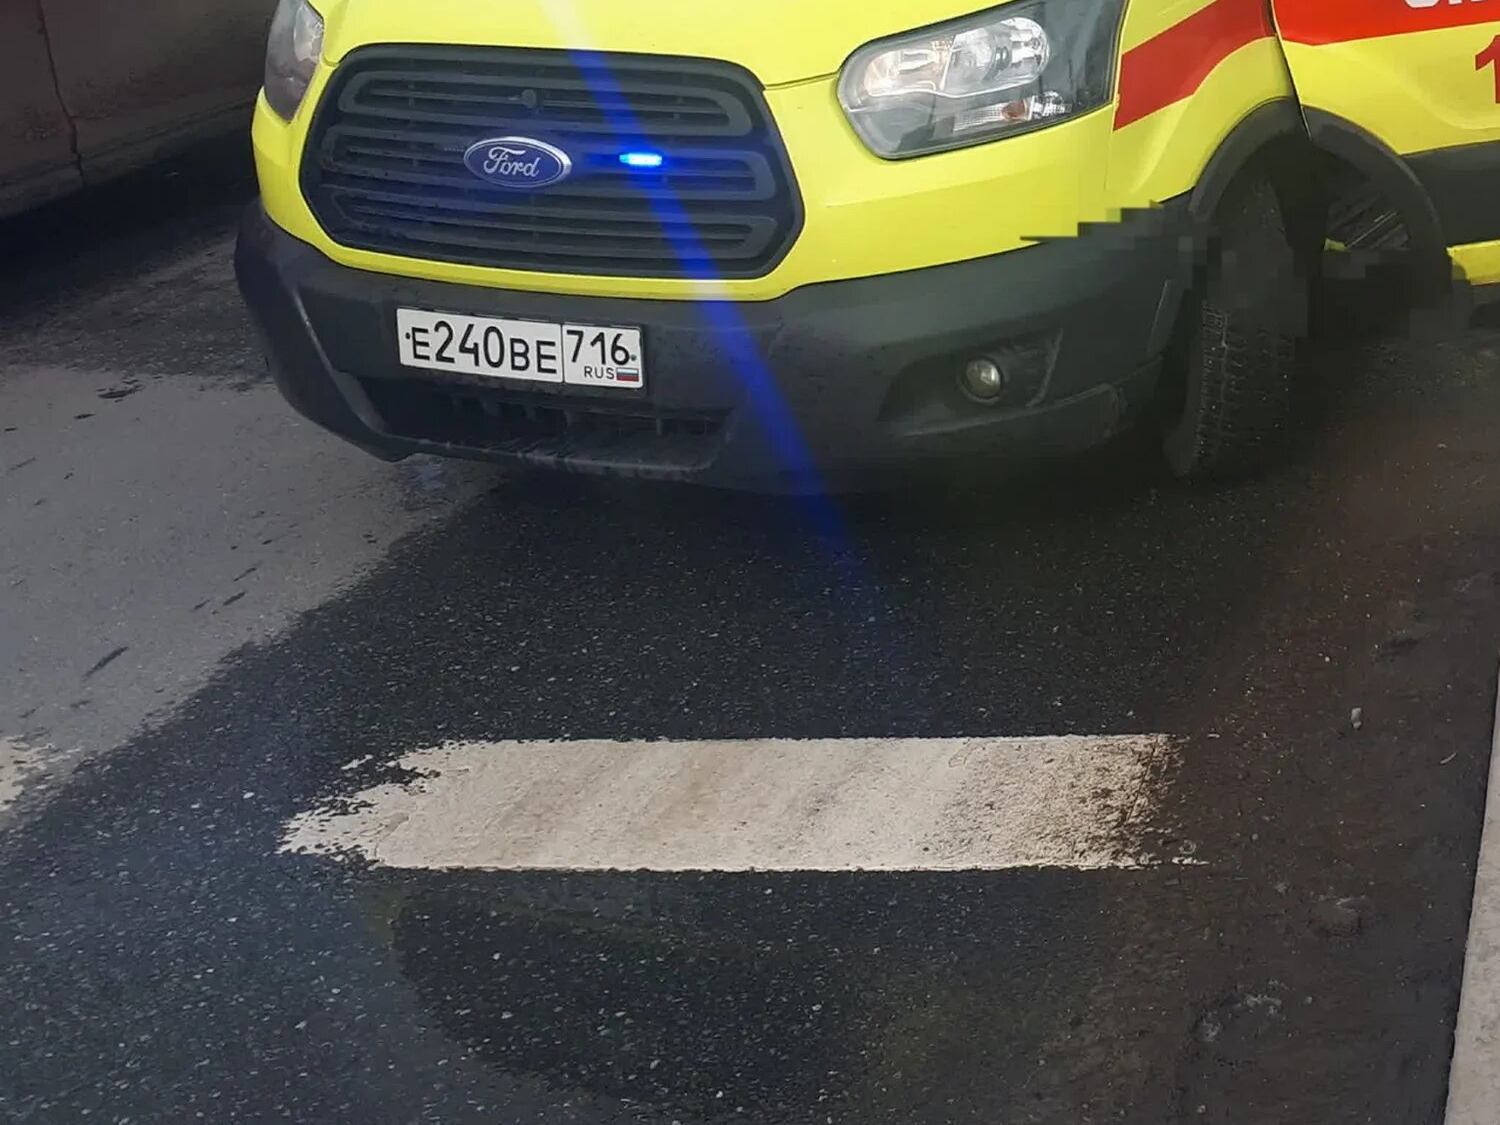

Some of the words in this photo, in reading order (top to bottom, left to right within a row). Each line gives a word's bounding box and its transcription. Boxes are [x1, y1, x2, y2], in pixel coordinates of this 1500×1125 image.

[484, 146, 540, 177] Ford
[566, 330, 630, 365] 716
[584, 366, 614, 379] RUS
